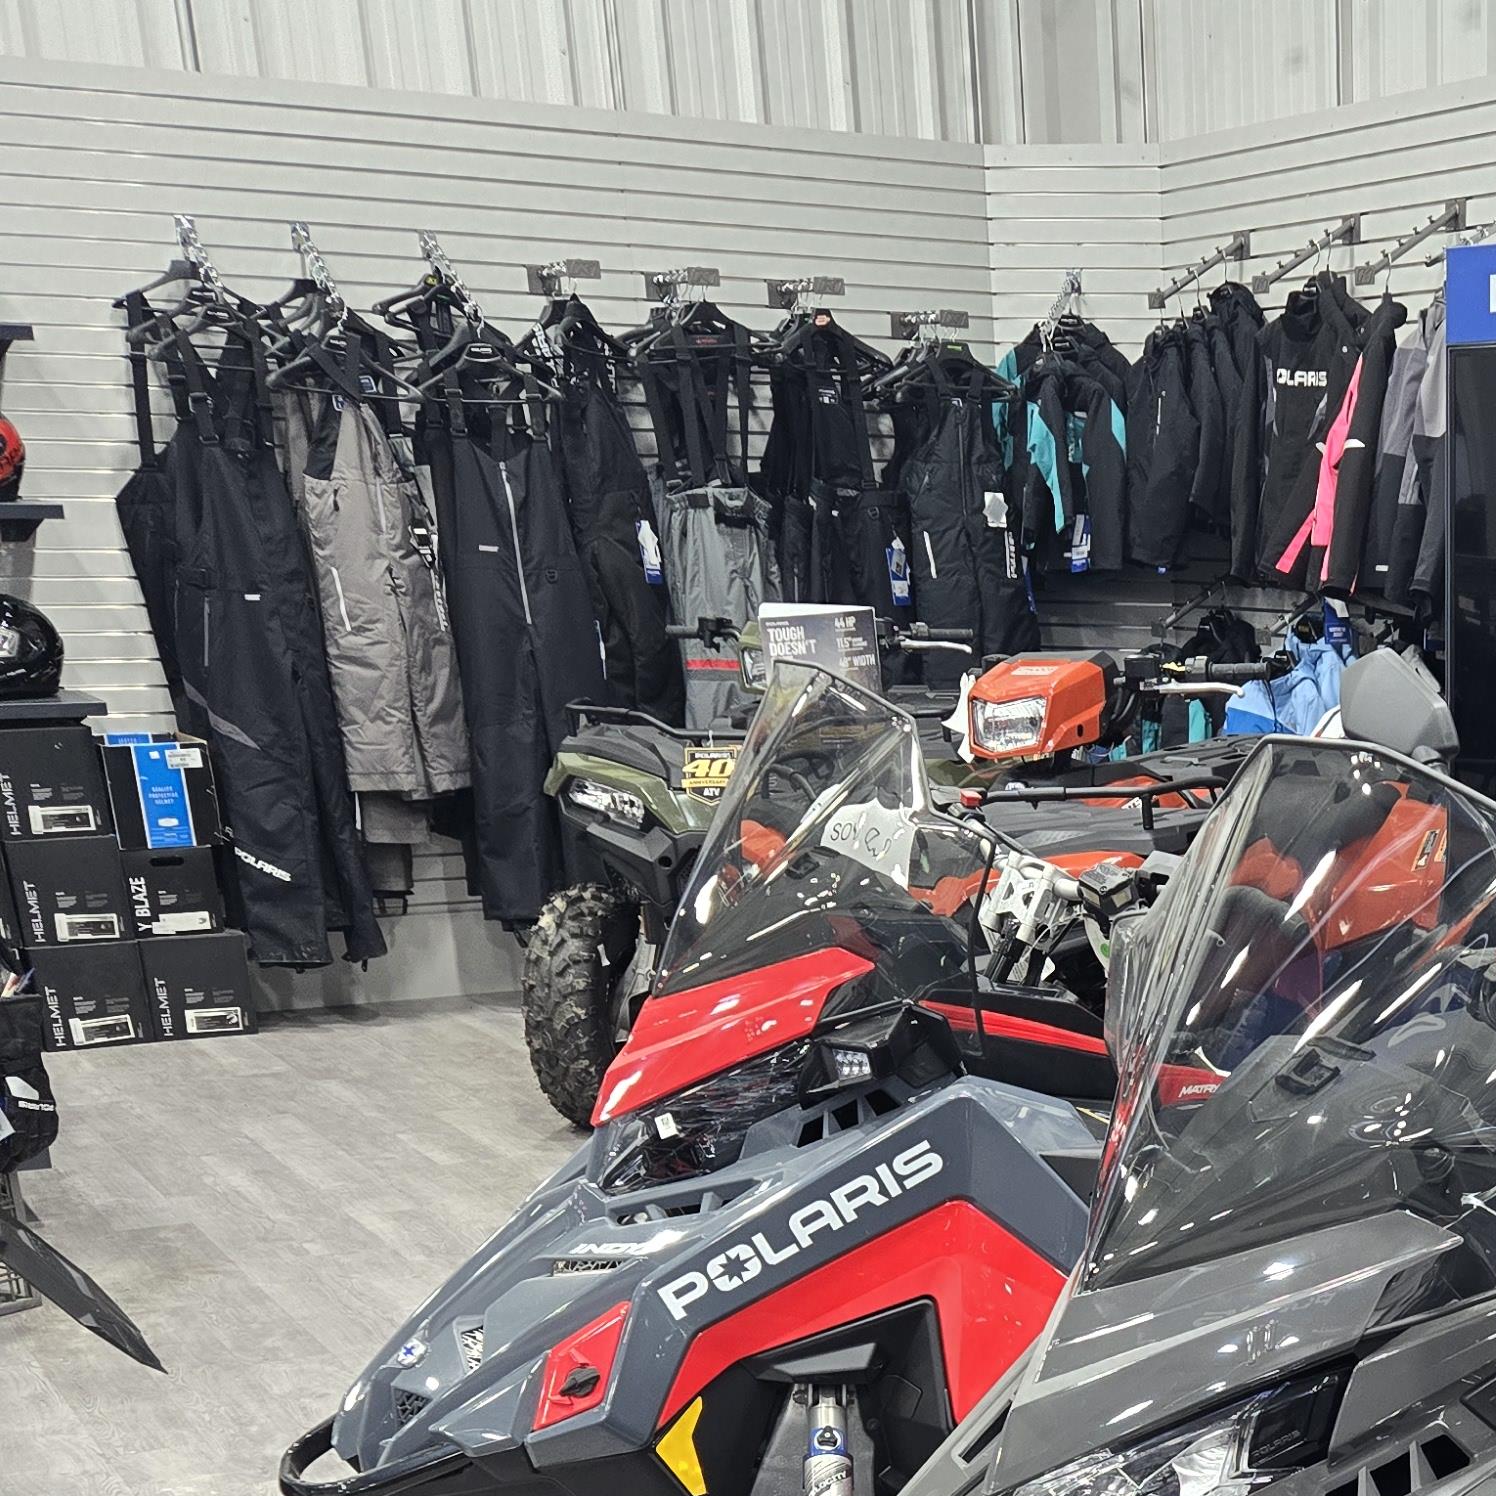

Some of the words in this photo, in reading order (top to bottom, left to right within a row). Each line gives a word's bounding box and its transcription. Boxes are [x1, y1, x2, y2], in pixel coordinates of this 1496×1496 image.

[1276, 368, 1328, 387] OLARIS
[767, 626, 805, 642] TOUGH
[769, 639, 817, 657] DOESN'T
[853, 653, 876, 667] WIDTH
[682, 759, 736, 777] 40
[234, 846, 292, 882] POLARIS
[129, 876, 152, 918] BLAZE
[23, 880, 46, 943] HELMET
[44, 986, 67, 1047] HELMET
[154, 977, 175, 1037] HELMET
[1177, 1083, 1222, 1098] MATRY
[657, 1139, 943, 1321] POLARIS
